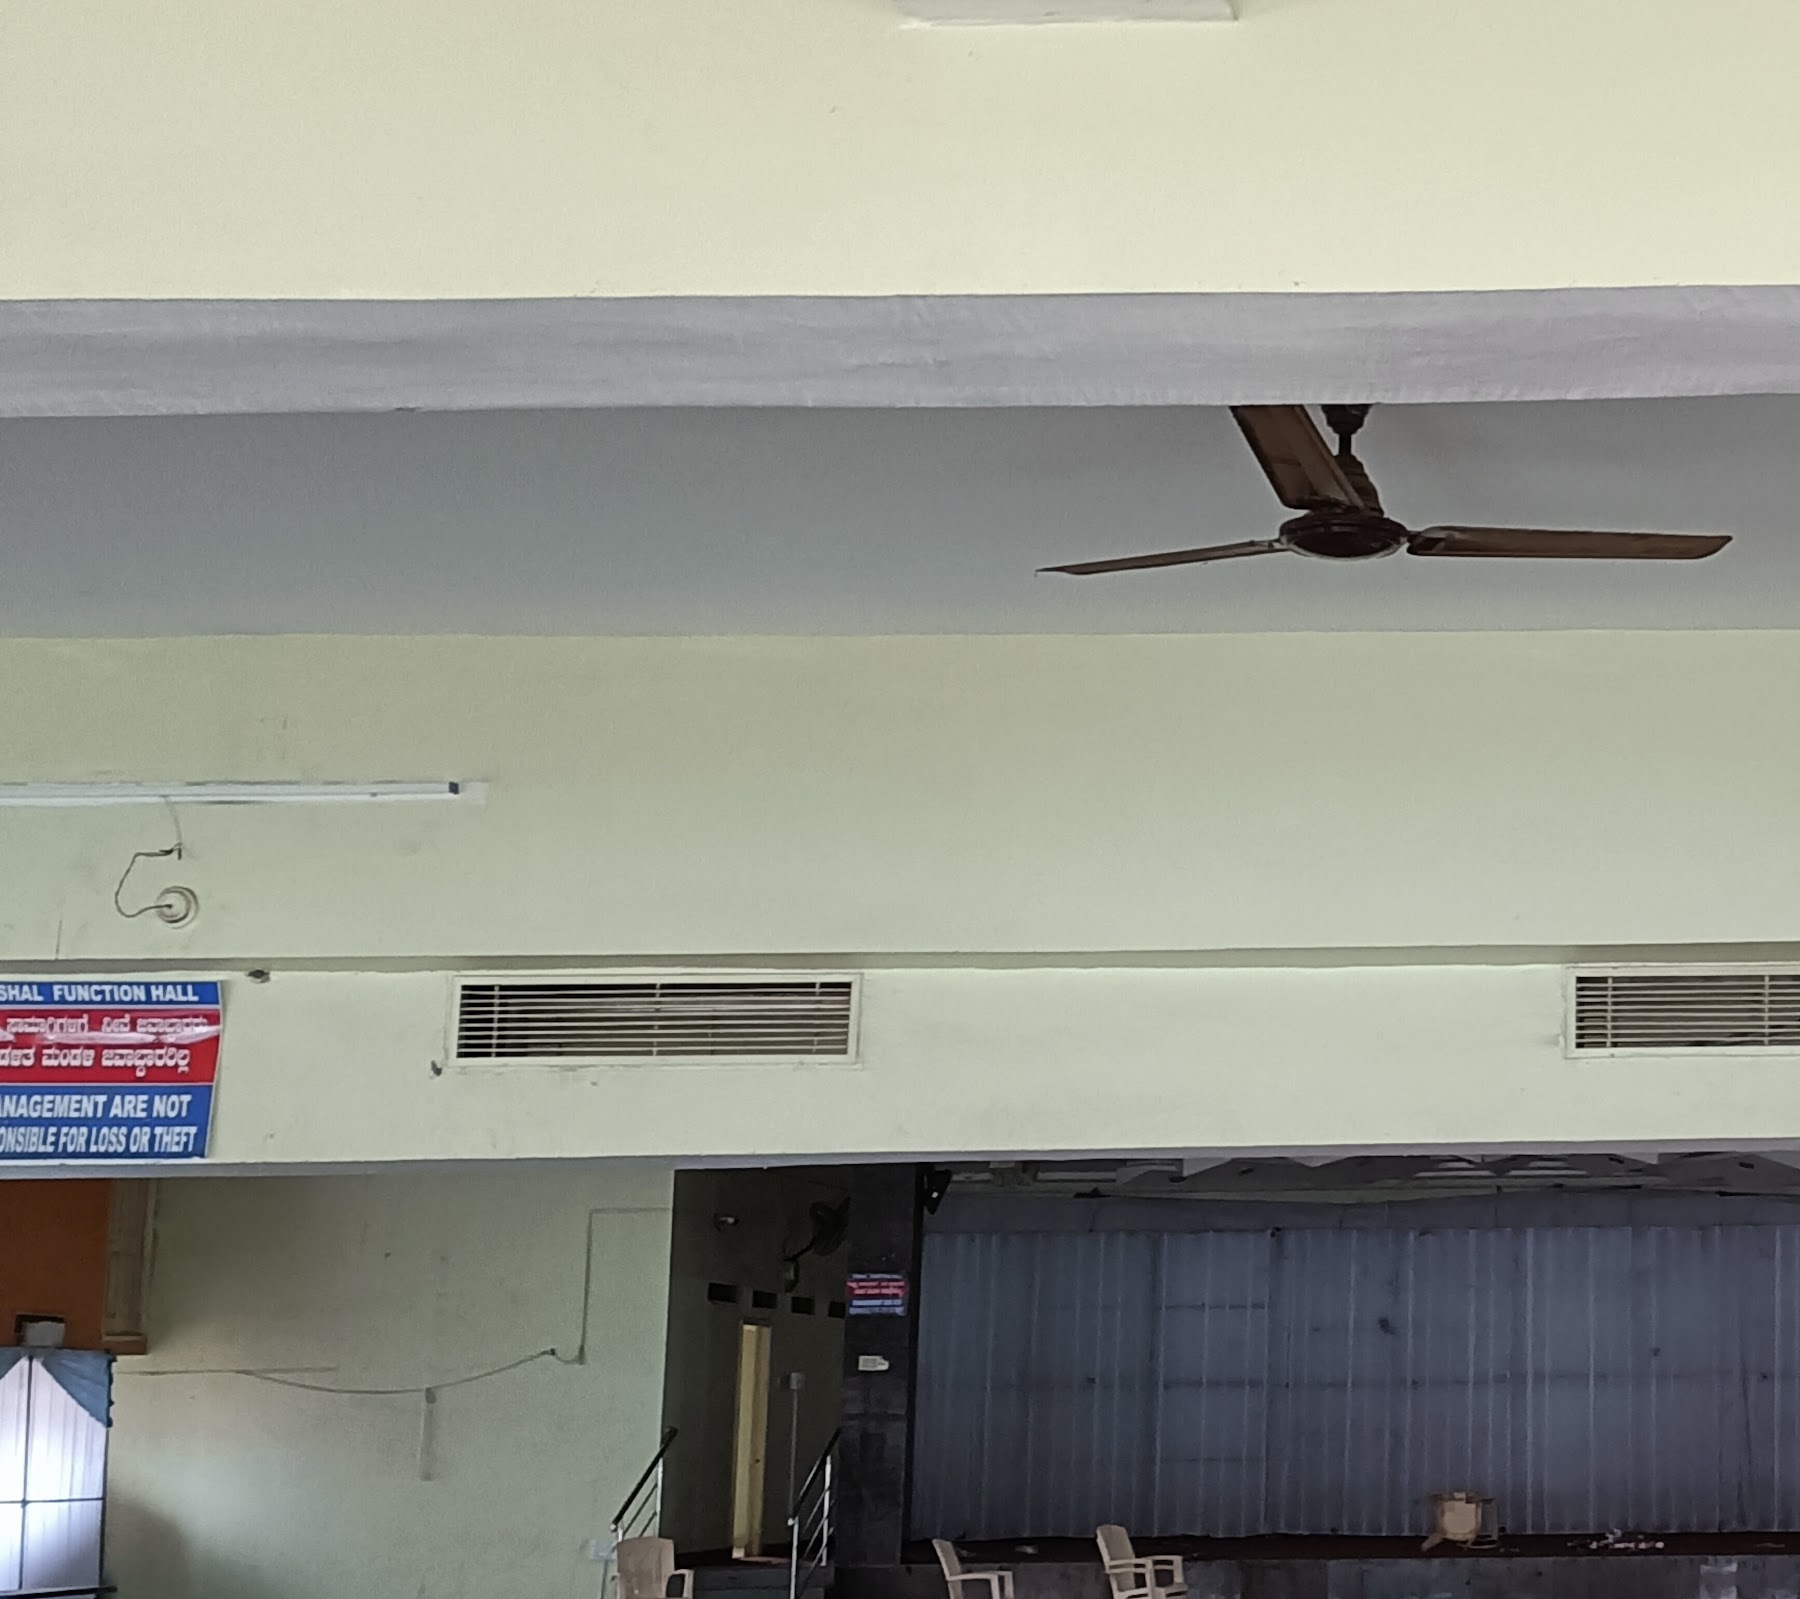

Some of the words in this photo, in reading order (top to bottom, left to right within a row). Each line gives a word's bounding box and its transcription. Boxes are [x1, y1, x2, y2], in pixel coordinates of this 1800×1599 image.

[0, 984, 43, 1002] SHAL
[53, 984, 146, 1002] FUNCTION
[151, 984, 199, 1002] HALL
[0, 1094, 107, 1119] NAGEMENT
[109, 1094, 149, 1119] ARE
[152, 1094, 192, 1119] NOT
[57, 1126, 88, 1153] FOR
[89, 1126, 127, 1153] LOSS
[129, 1126, 151, 1153] OR
[153, 1125, 198, 1153] THEFT
